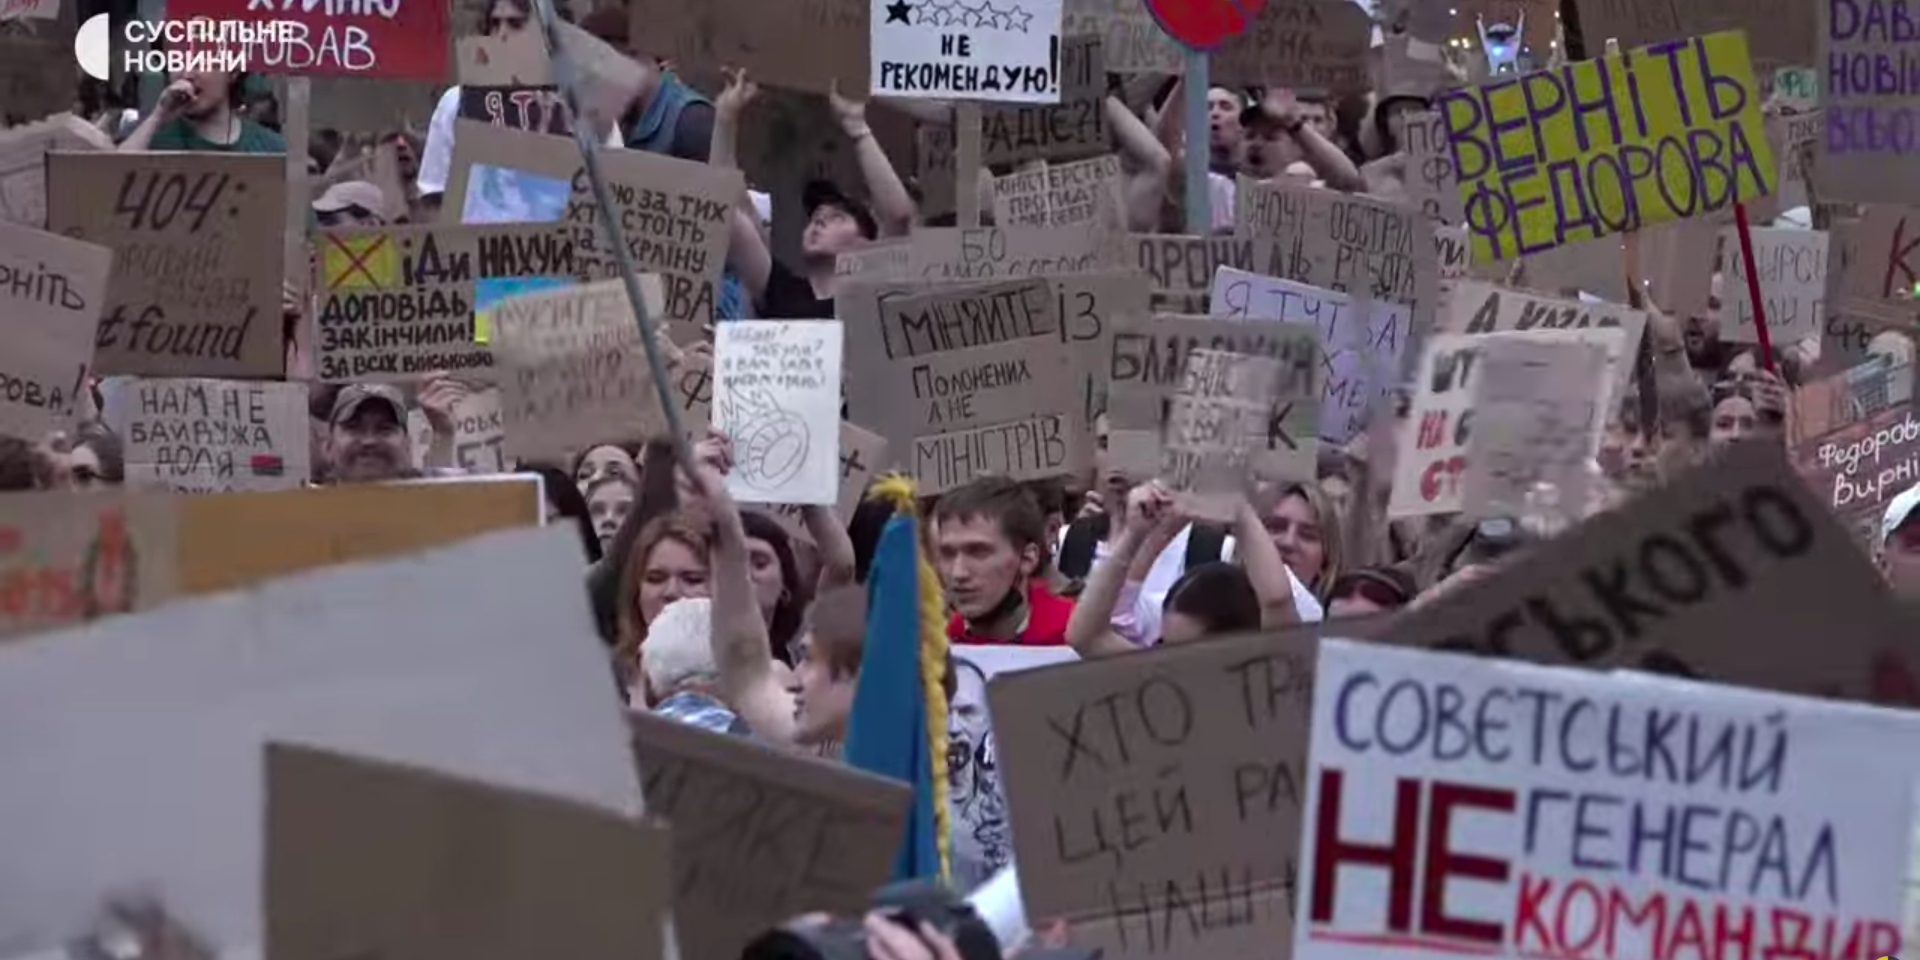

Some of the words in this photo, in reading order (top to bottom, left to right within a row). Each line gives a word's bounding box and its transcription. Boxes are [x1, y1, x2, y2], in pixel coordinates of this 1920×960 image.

[880, 35, 1058, 93] РЕКОМЕНДУЮ!
[940, 34, 971, 56] НЕ
[1440, 38, 1747, 182] ВЕРНІТЬ
[114, 170, 247, 234] 404:
[679, 194, 729, 223] ТИХ
[1464, 120, 1769, 260] ФЕДОРОВА
[478, 230, 575, 279] НАХУЙ
[130, 304, 258, 361] found
[319, 287, 467, 326] ДОПОВІДЬ
[321, 311, 476, 351] ЗАКІНЧИЛИ!
[320, 354, 349, 379] ЗА
[140, 383, 209, 418] НАМ
[222, 388, 267, 425] НЕ
[155, 446, 235, 478] ДОЛЯ
[1046, 675, 1195, 785] ХТО
[1334, 671, 1789, 795] СОВЄТСЬКИЙ
[1053, 763, 1195, 872] ЦЕЙ
[1310, 766, 1517, 944] НЕ
[1522, 788, 1839, 906] ГЕНЕРАЛ
